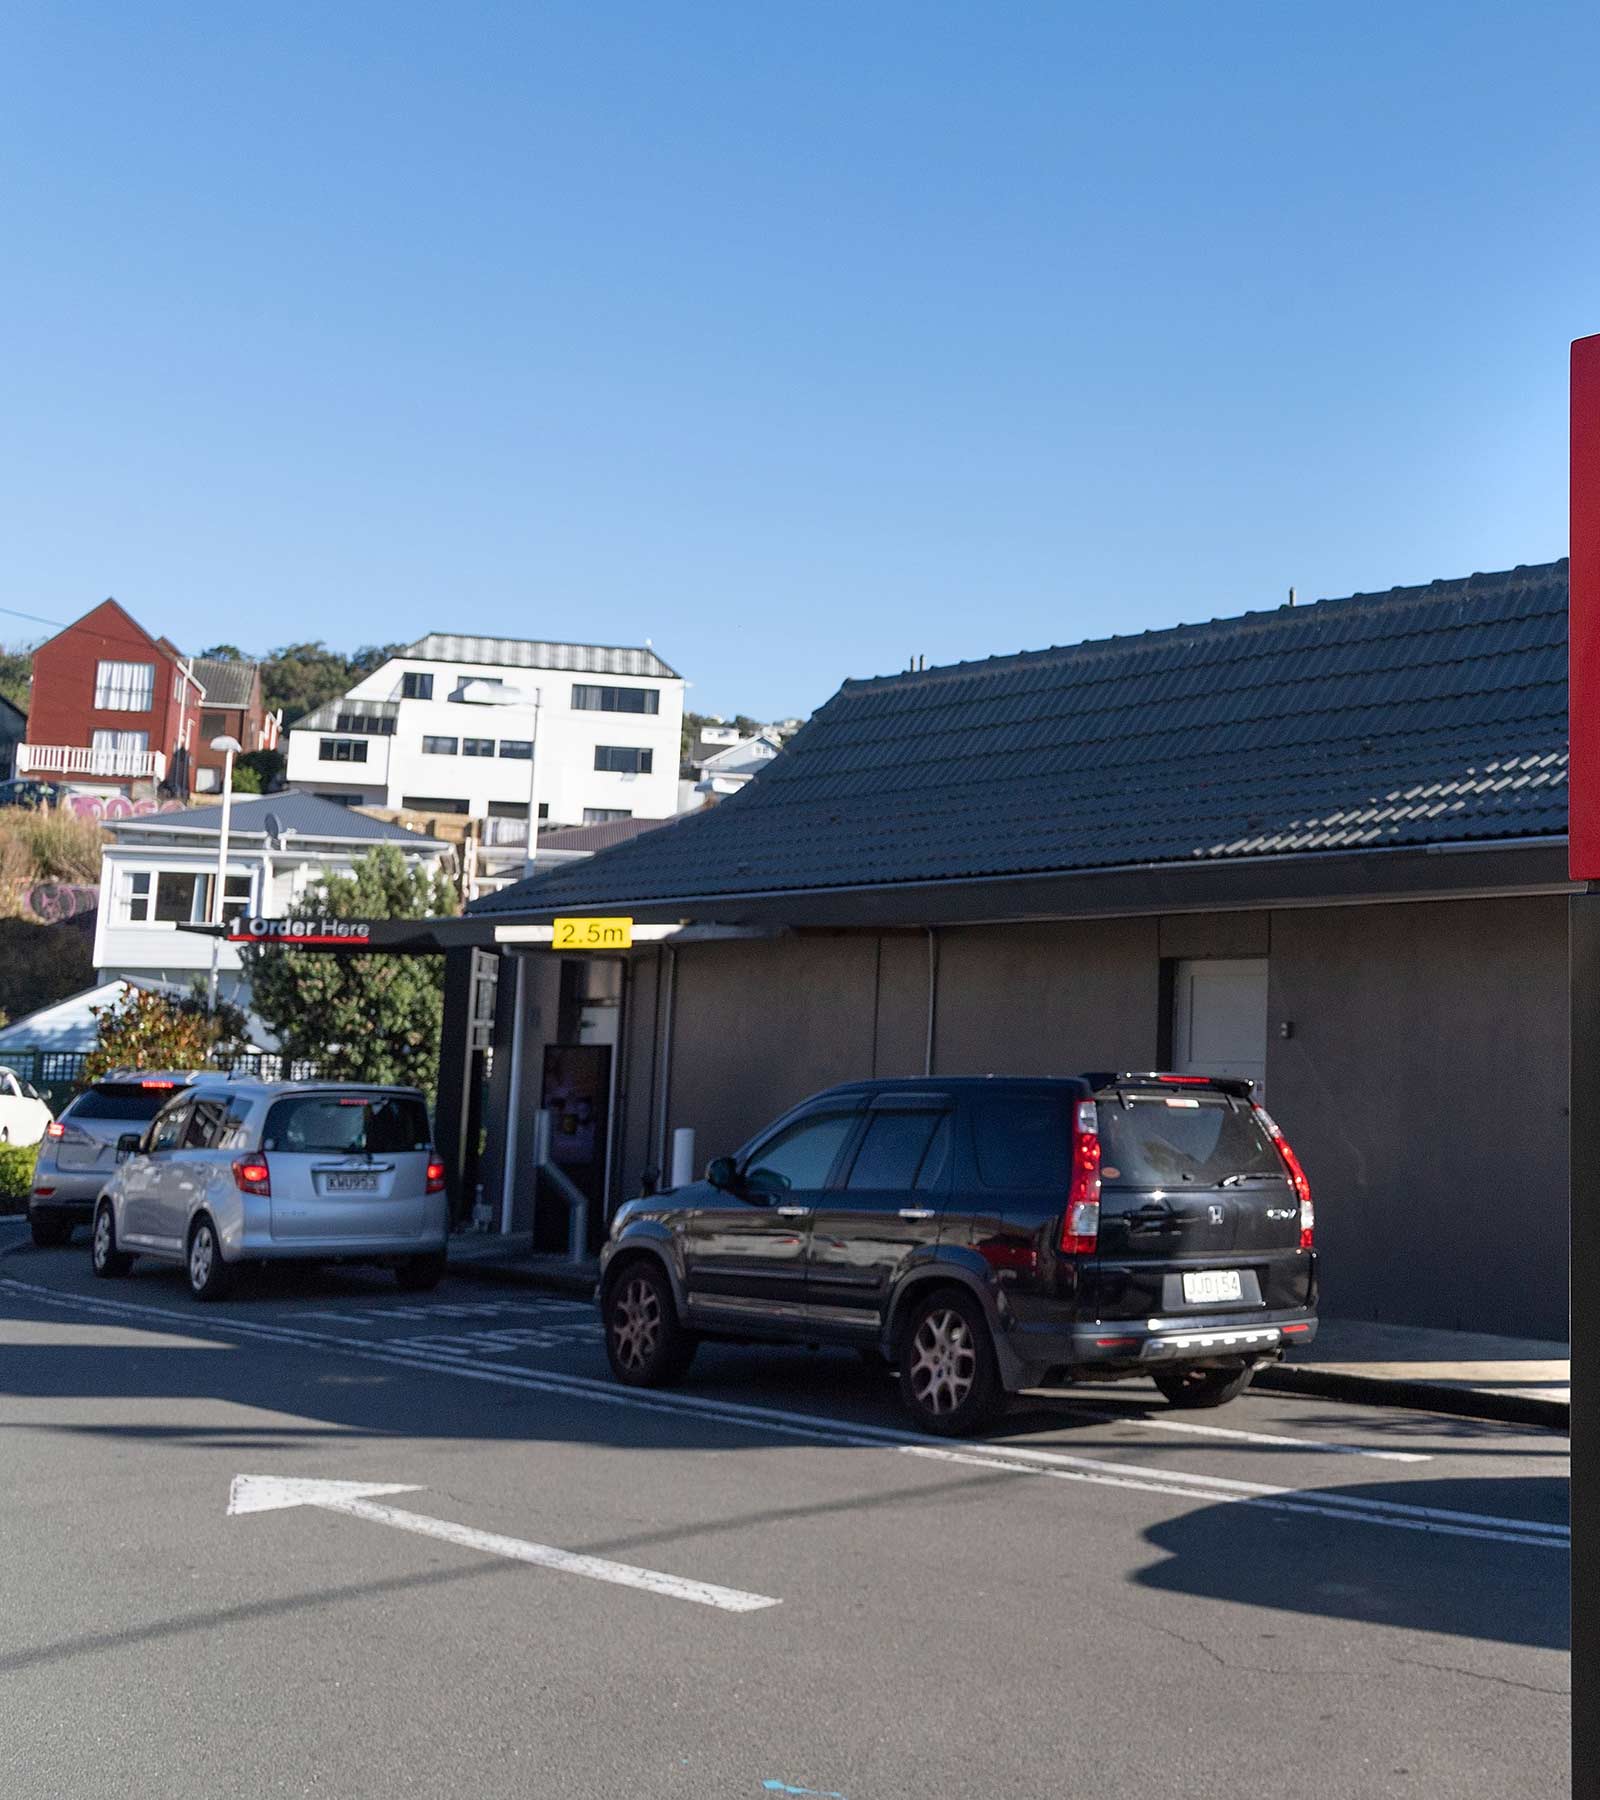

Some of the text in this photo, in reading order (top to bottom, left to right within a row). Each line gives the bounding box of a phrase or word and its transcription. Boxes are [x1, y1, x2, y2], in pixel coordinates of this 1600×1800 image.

[249, 917, 316, 937] Order
[320, 919, 371, 938] Here
[562, 924, 624, 944] 2.5m
